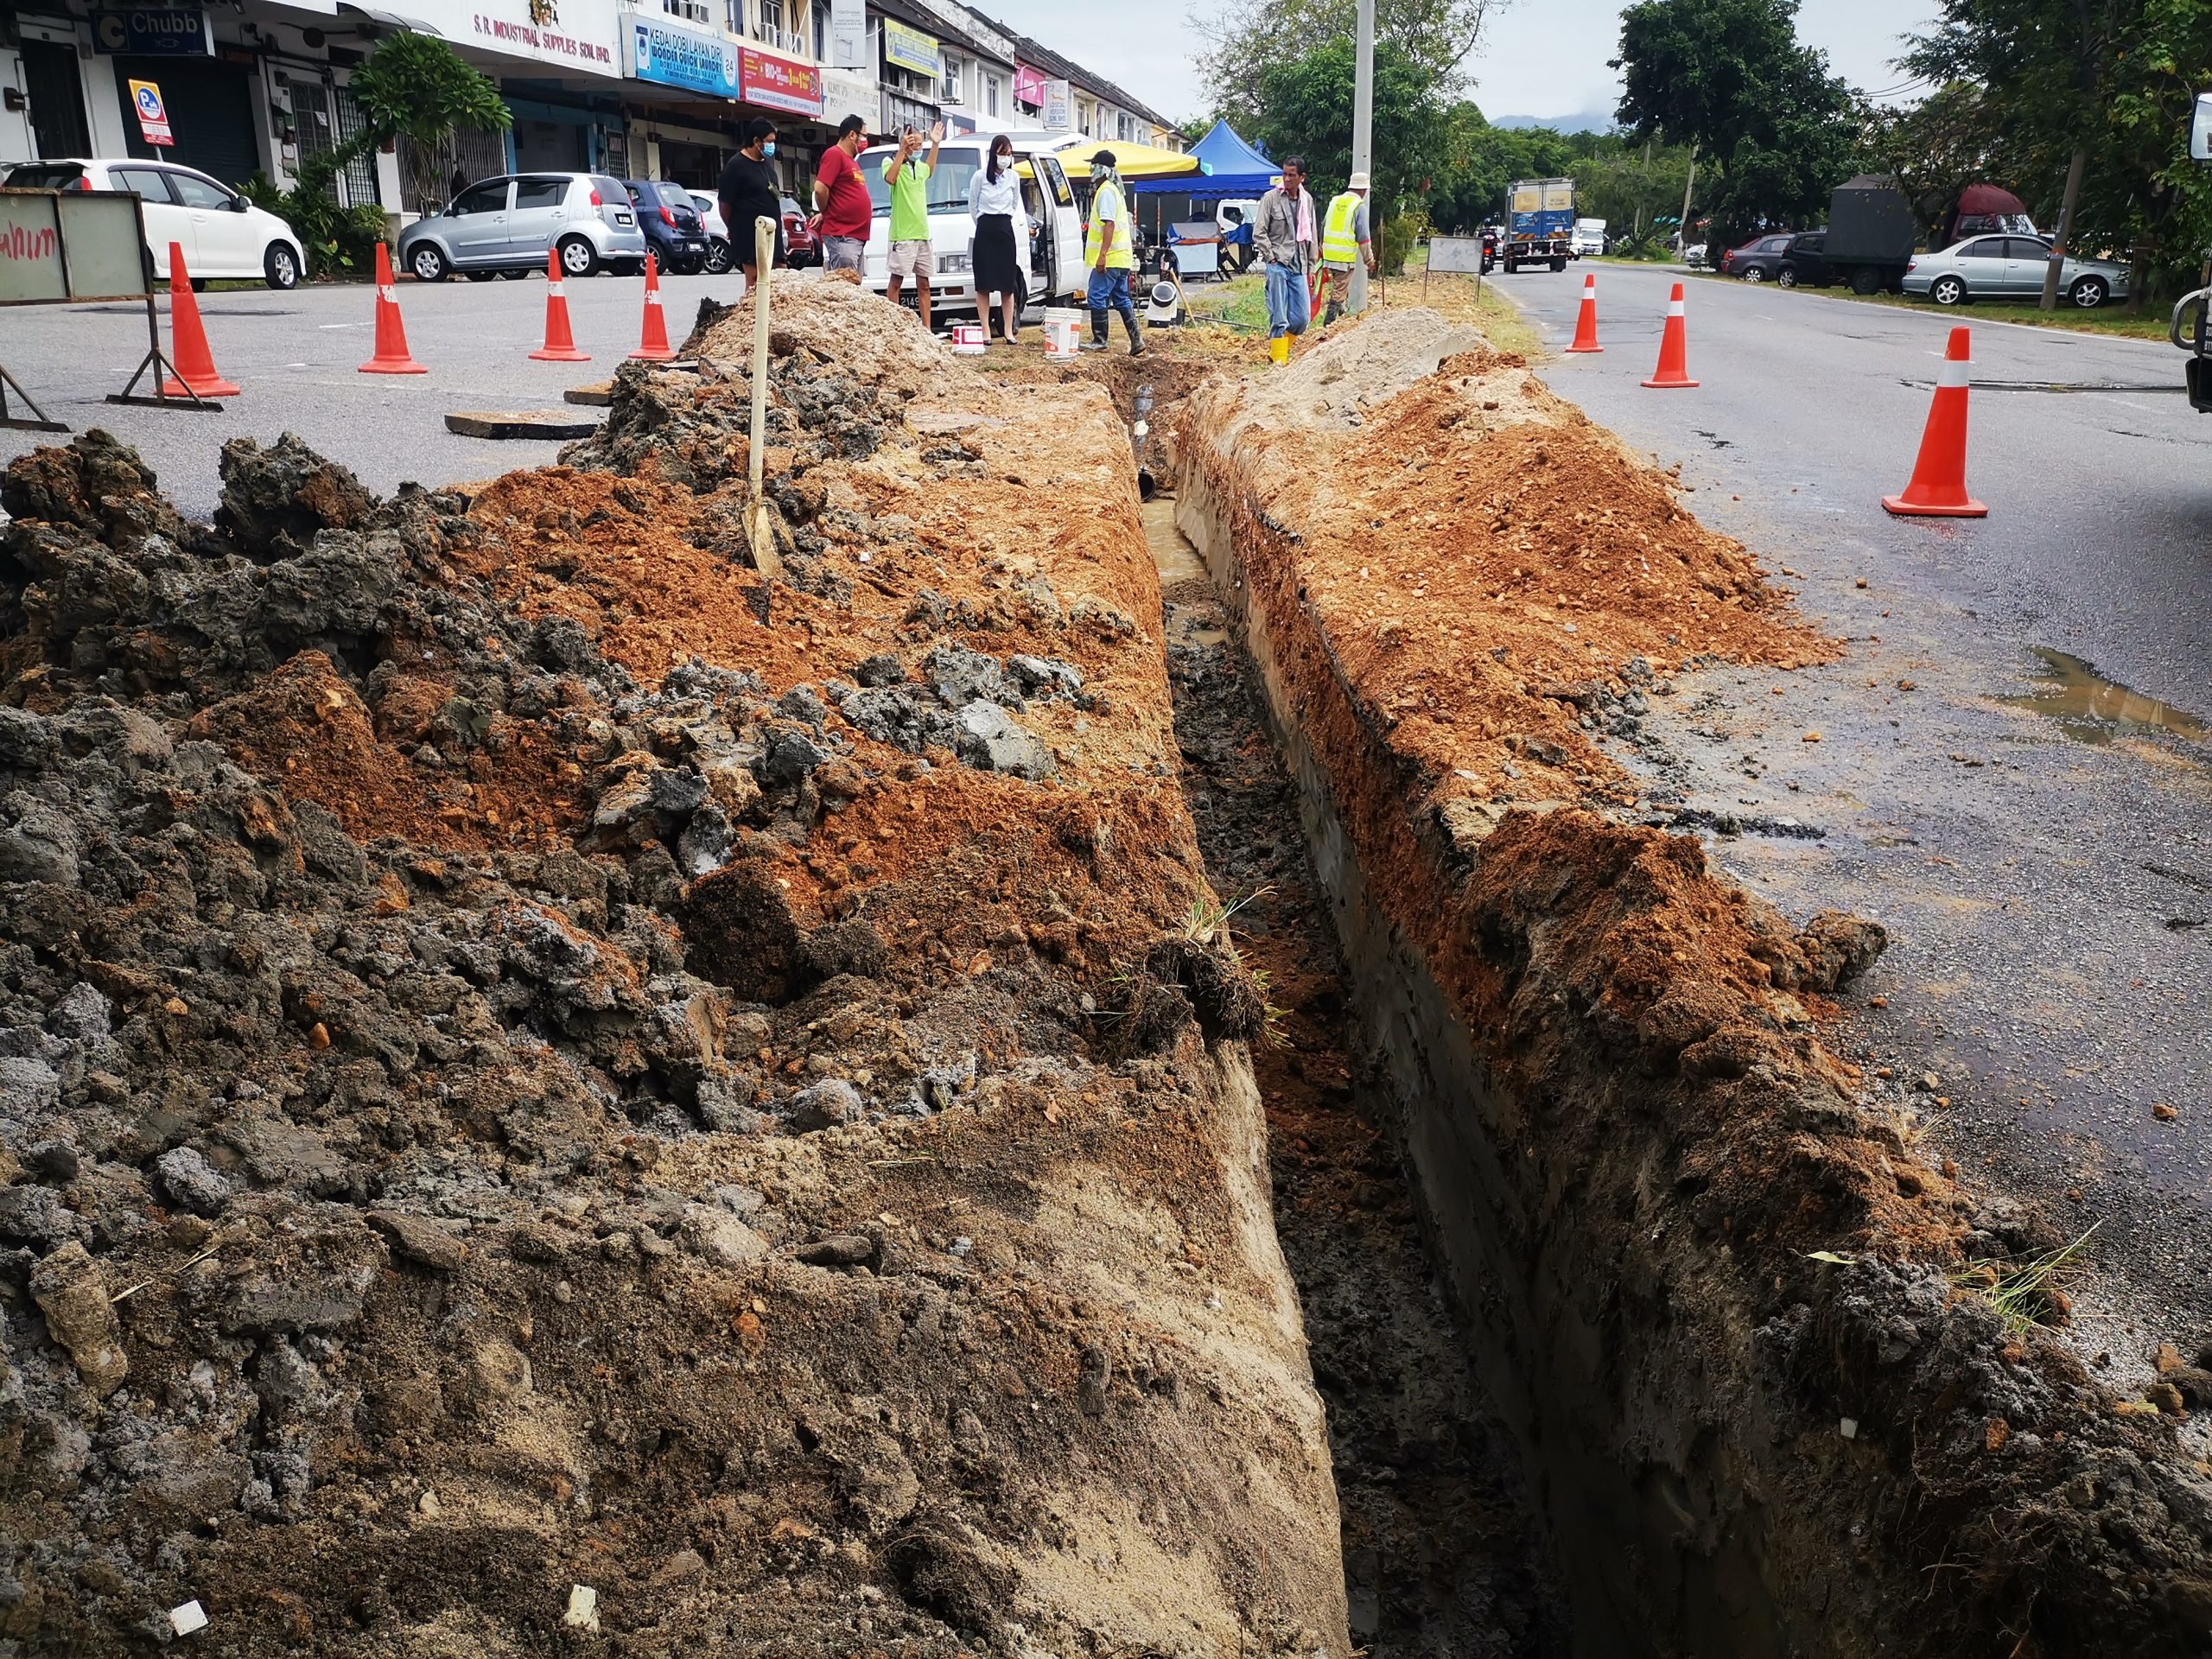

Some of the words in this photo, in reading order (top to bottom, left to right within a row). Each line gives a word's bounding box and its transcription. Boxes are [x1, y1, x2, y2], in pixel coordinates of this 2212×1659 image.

[131, 12, 198, 34] Chubb
[493, 19, 539, 48] INDUSTRIAL
[543, 32, 577, 56] SUPPLIES
[650, 28, 671, 47] KEDAI
[672, 34, 688, 52] DOBI
[690, 39, 710, 57] LAYAN
[710, 46, 721, 61] DIRI
[651, 45, 677, 63] WONDER
[679, 52, 697, 67] QUICK
[699, 59, 722, 73] LAUNDRY
[725, 59, 734, 72] 24
